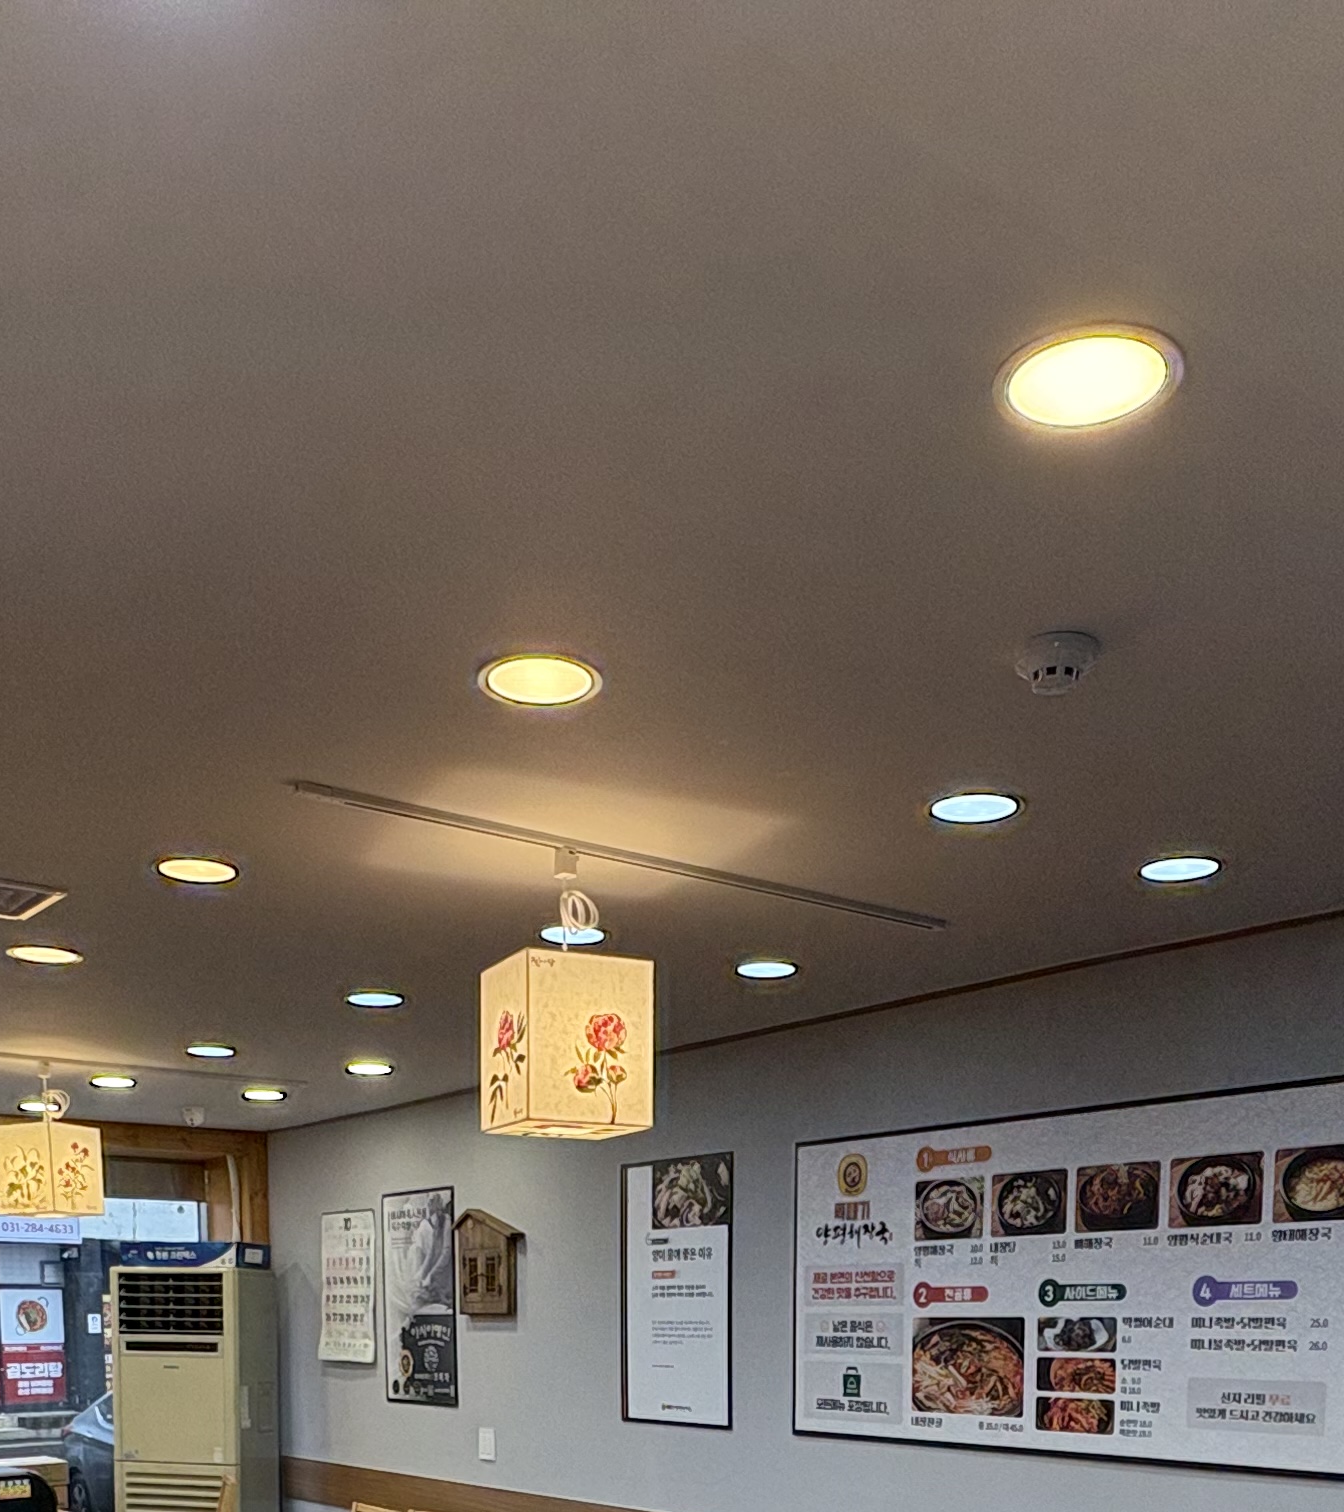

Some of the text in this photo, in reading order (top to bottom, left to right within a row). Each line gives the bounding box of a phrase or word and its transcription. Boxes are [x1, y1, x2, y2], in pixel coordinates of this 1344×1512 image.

[1044, 1285, 1054, 1302] 3
[1199, 1283, 1212, 1300] 4
[1309, 1318, 1329, 1329] 25.0
